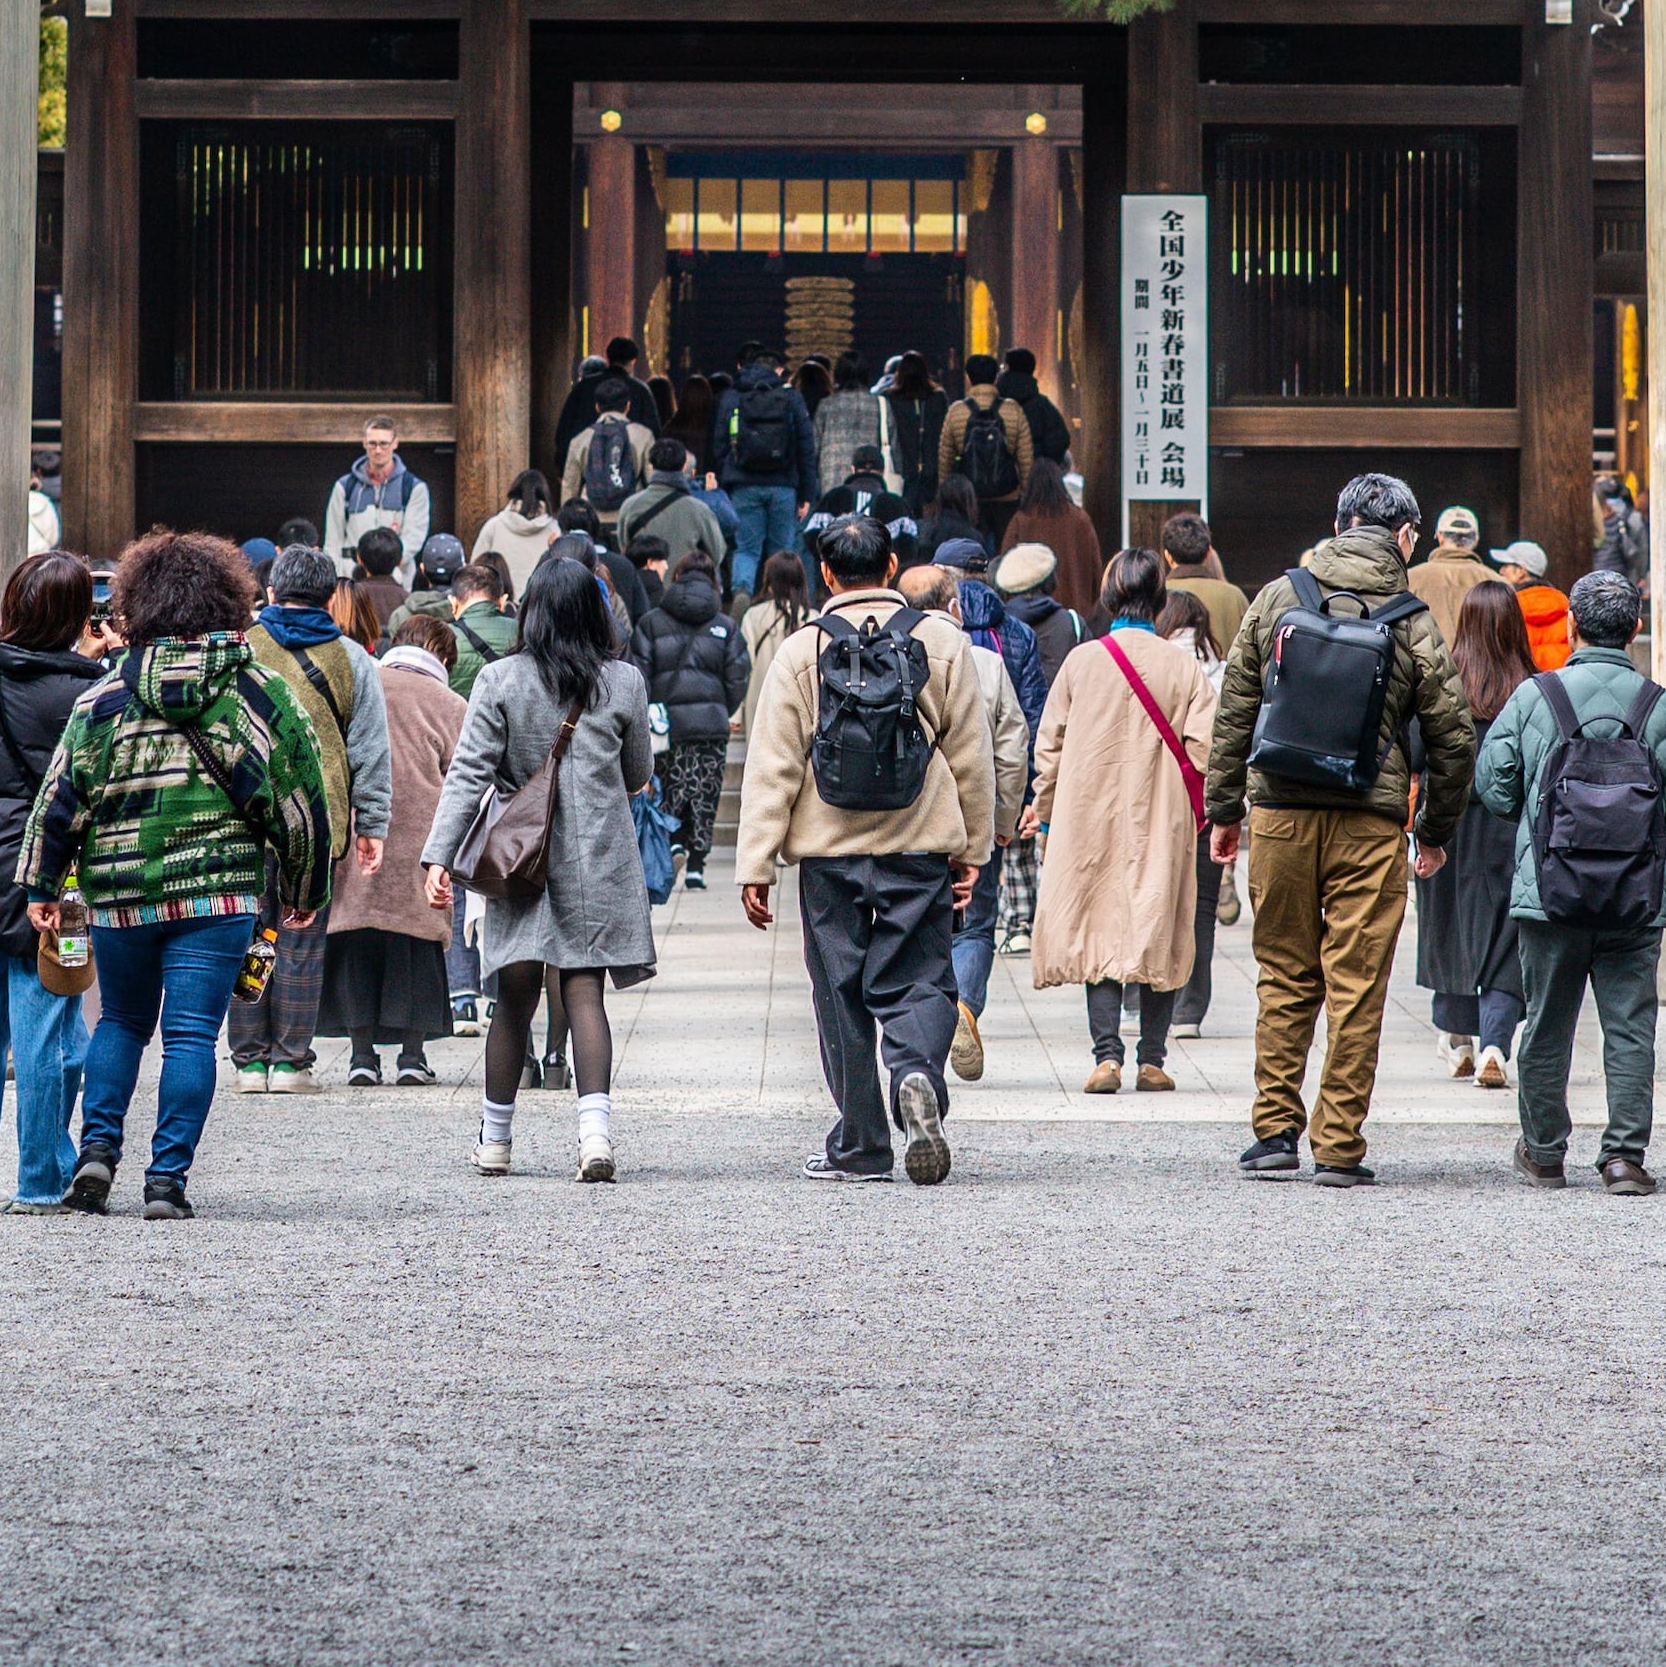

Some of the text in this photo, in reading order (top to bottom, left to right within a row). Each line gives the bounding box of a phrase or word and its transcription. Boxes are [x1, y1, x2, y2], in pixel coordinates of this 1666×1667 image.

[1134, 278, 1150, 310] 期間
[1159, 209, 1186, 490] 全国少年新春書道展 会場
